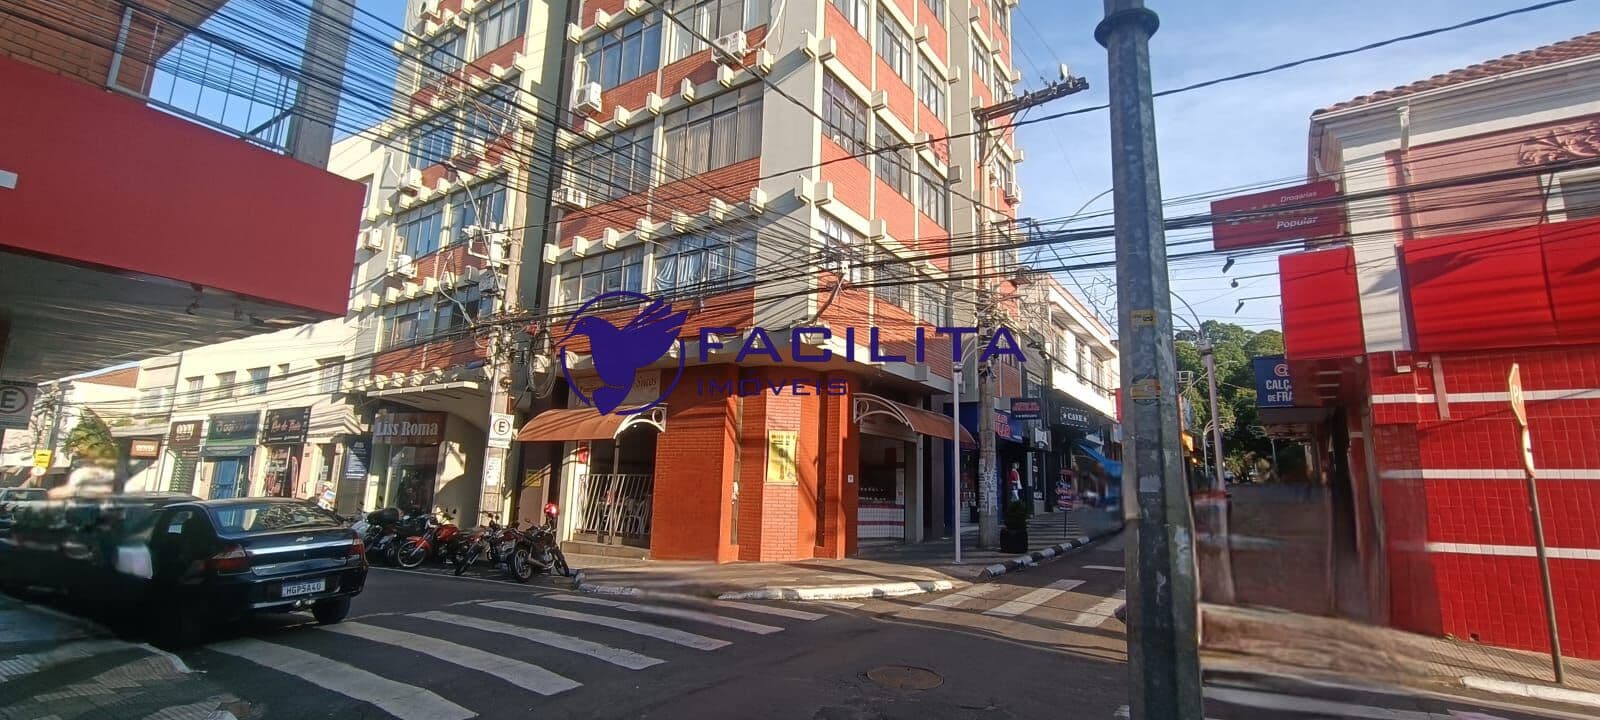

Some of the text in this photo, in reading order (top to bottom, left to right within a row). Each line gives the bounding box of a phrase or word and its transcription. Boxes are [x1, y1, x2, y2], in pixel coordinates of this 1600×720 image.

[1276, 216, 1318, 230] Popular
[1, 390, 18, 409] E
[375, 421, 439, 436] Liss Roma
[498, 421, 506, 433] E
